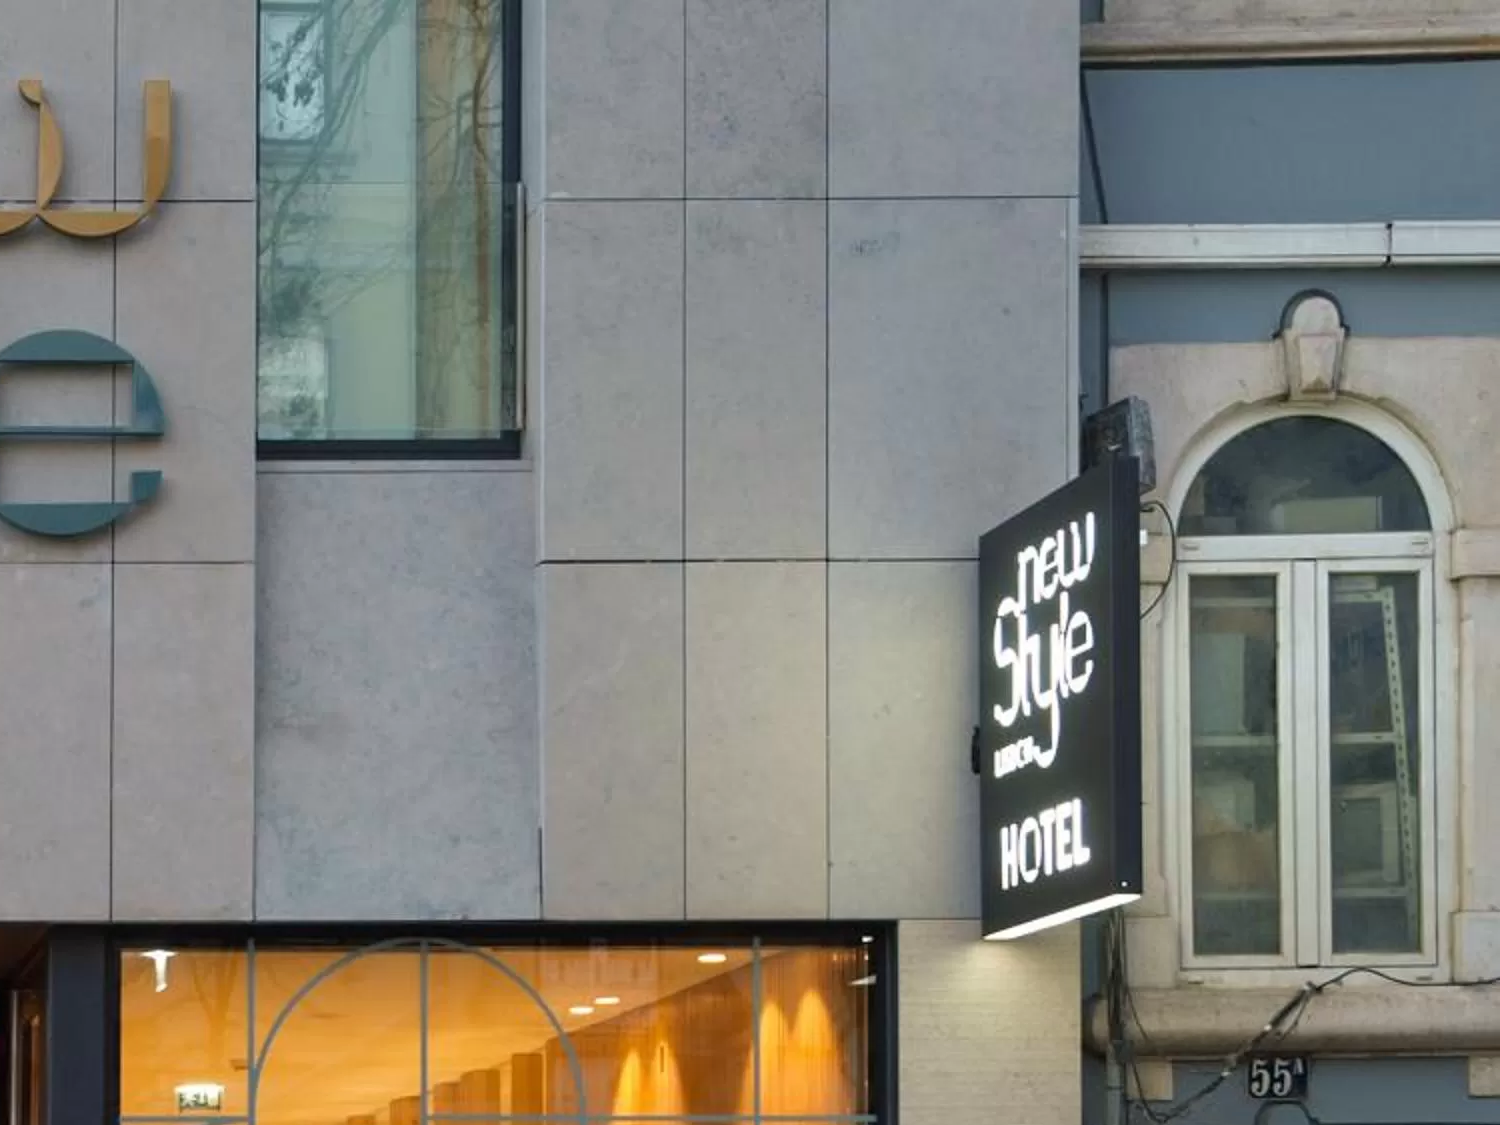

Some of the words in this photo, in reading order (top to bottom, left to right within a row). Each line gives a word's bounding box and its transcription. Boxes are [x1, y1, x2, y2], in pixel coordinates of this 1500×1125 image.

[1017, 511, 1096, 606] new
[993, 591, 1094, 768] Style
[1001, 798, 1090, 890] HOTEL
